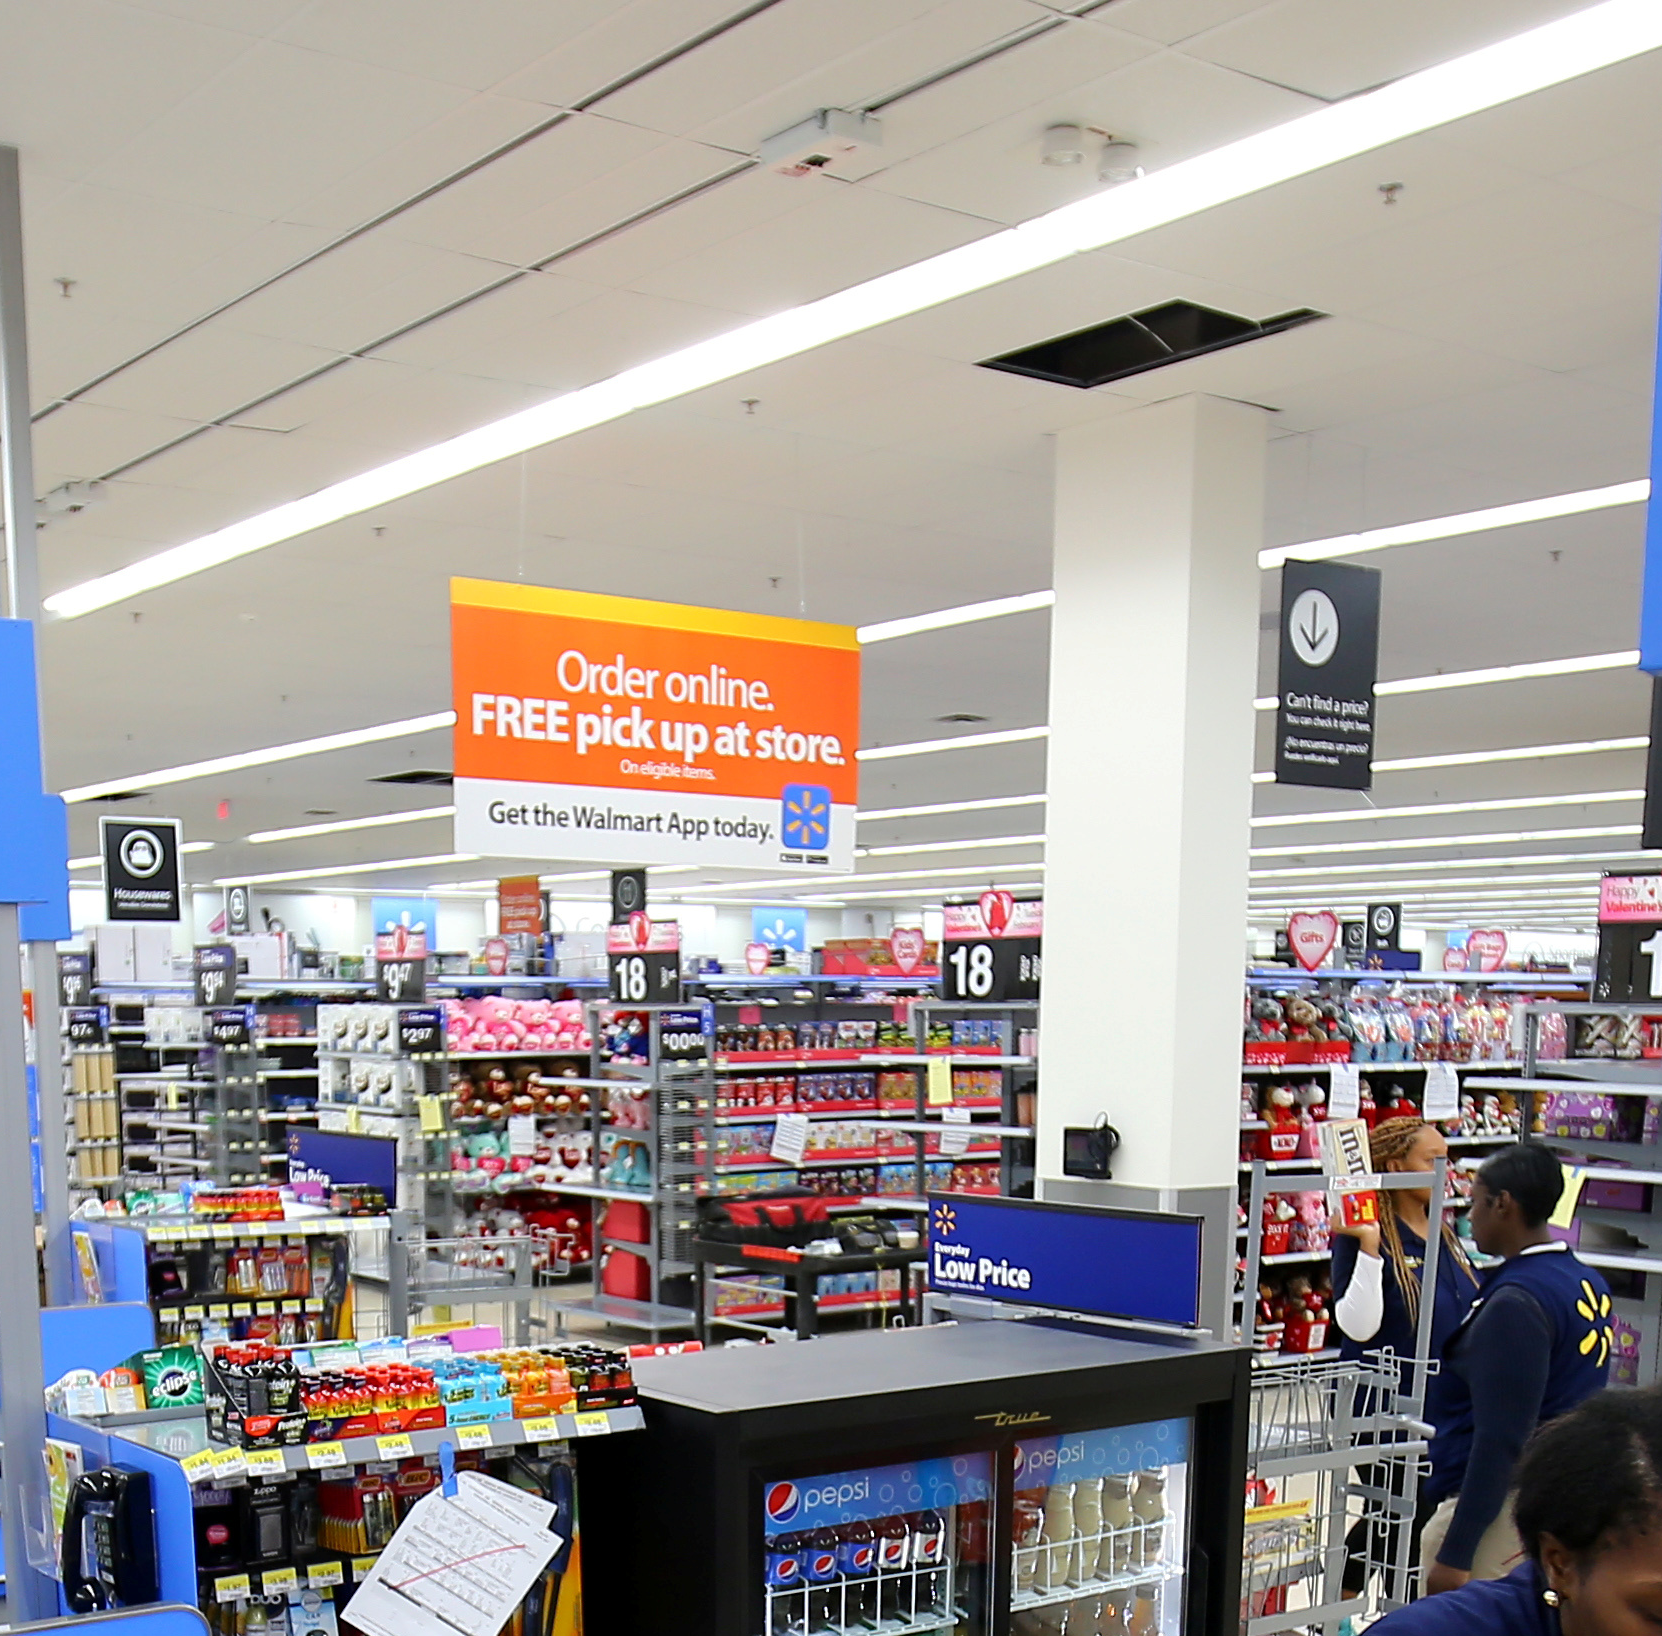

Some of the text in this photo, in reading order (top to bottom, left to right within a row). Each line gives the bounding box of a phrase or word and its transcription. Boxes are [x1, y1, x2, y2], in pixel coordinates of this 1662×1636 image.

[557, 649, 775, 712] Order online.
[1287, 692, 1369, 717] Can't find a price?
[472, 692, 845, 766] FREE pick up at store.
[620, 759, 716, 780] On eligible items.
[488, 801, 774, 842] Get the Walmart App today.
[114, 888, 172, 901] Housewares
[1606, 884, 1638, 900] Happy
[1300, 931, 1324, 944] Gifts
[615, 957, 647, 1000] 18
[949, 944, 995, 998] 18
[934, 1241, 971, 1258] Everyday
[935, 1253, 1032, 1291] Low Price
[152, 1370, 198, 1397] eclipse
[1028, 1439, 1085, 1475] pepsi
[804, 1478, 870, 1512] pepsi
